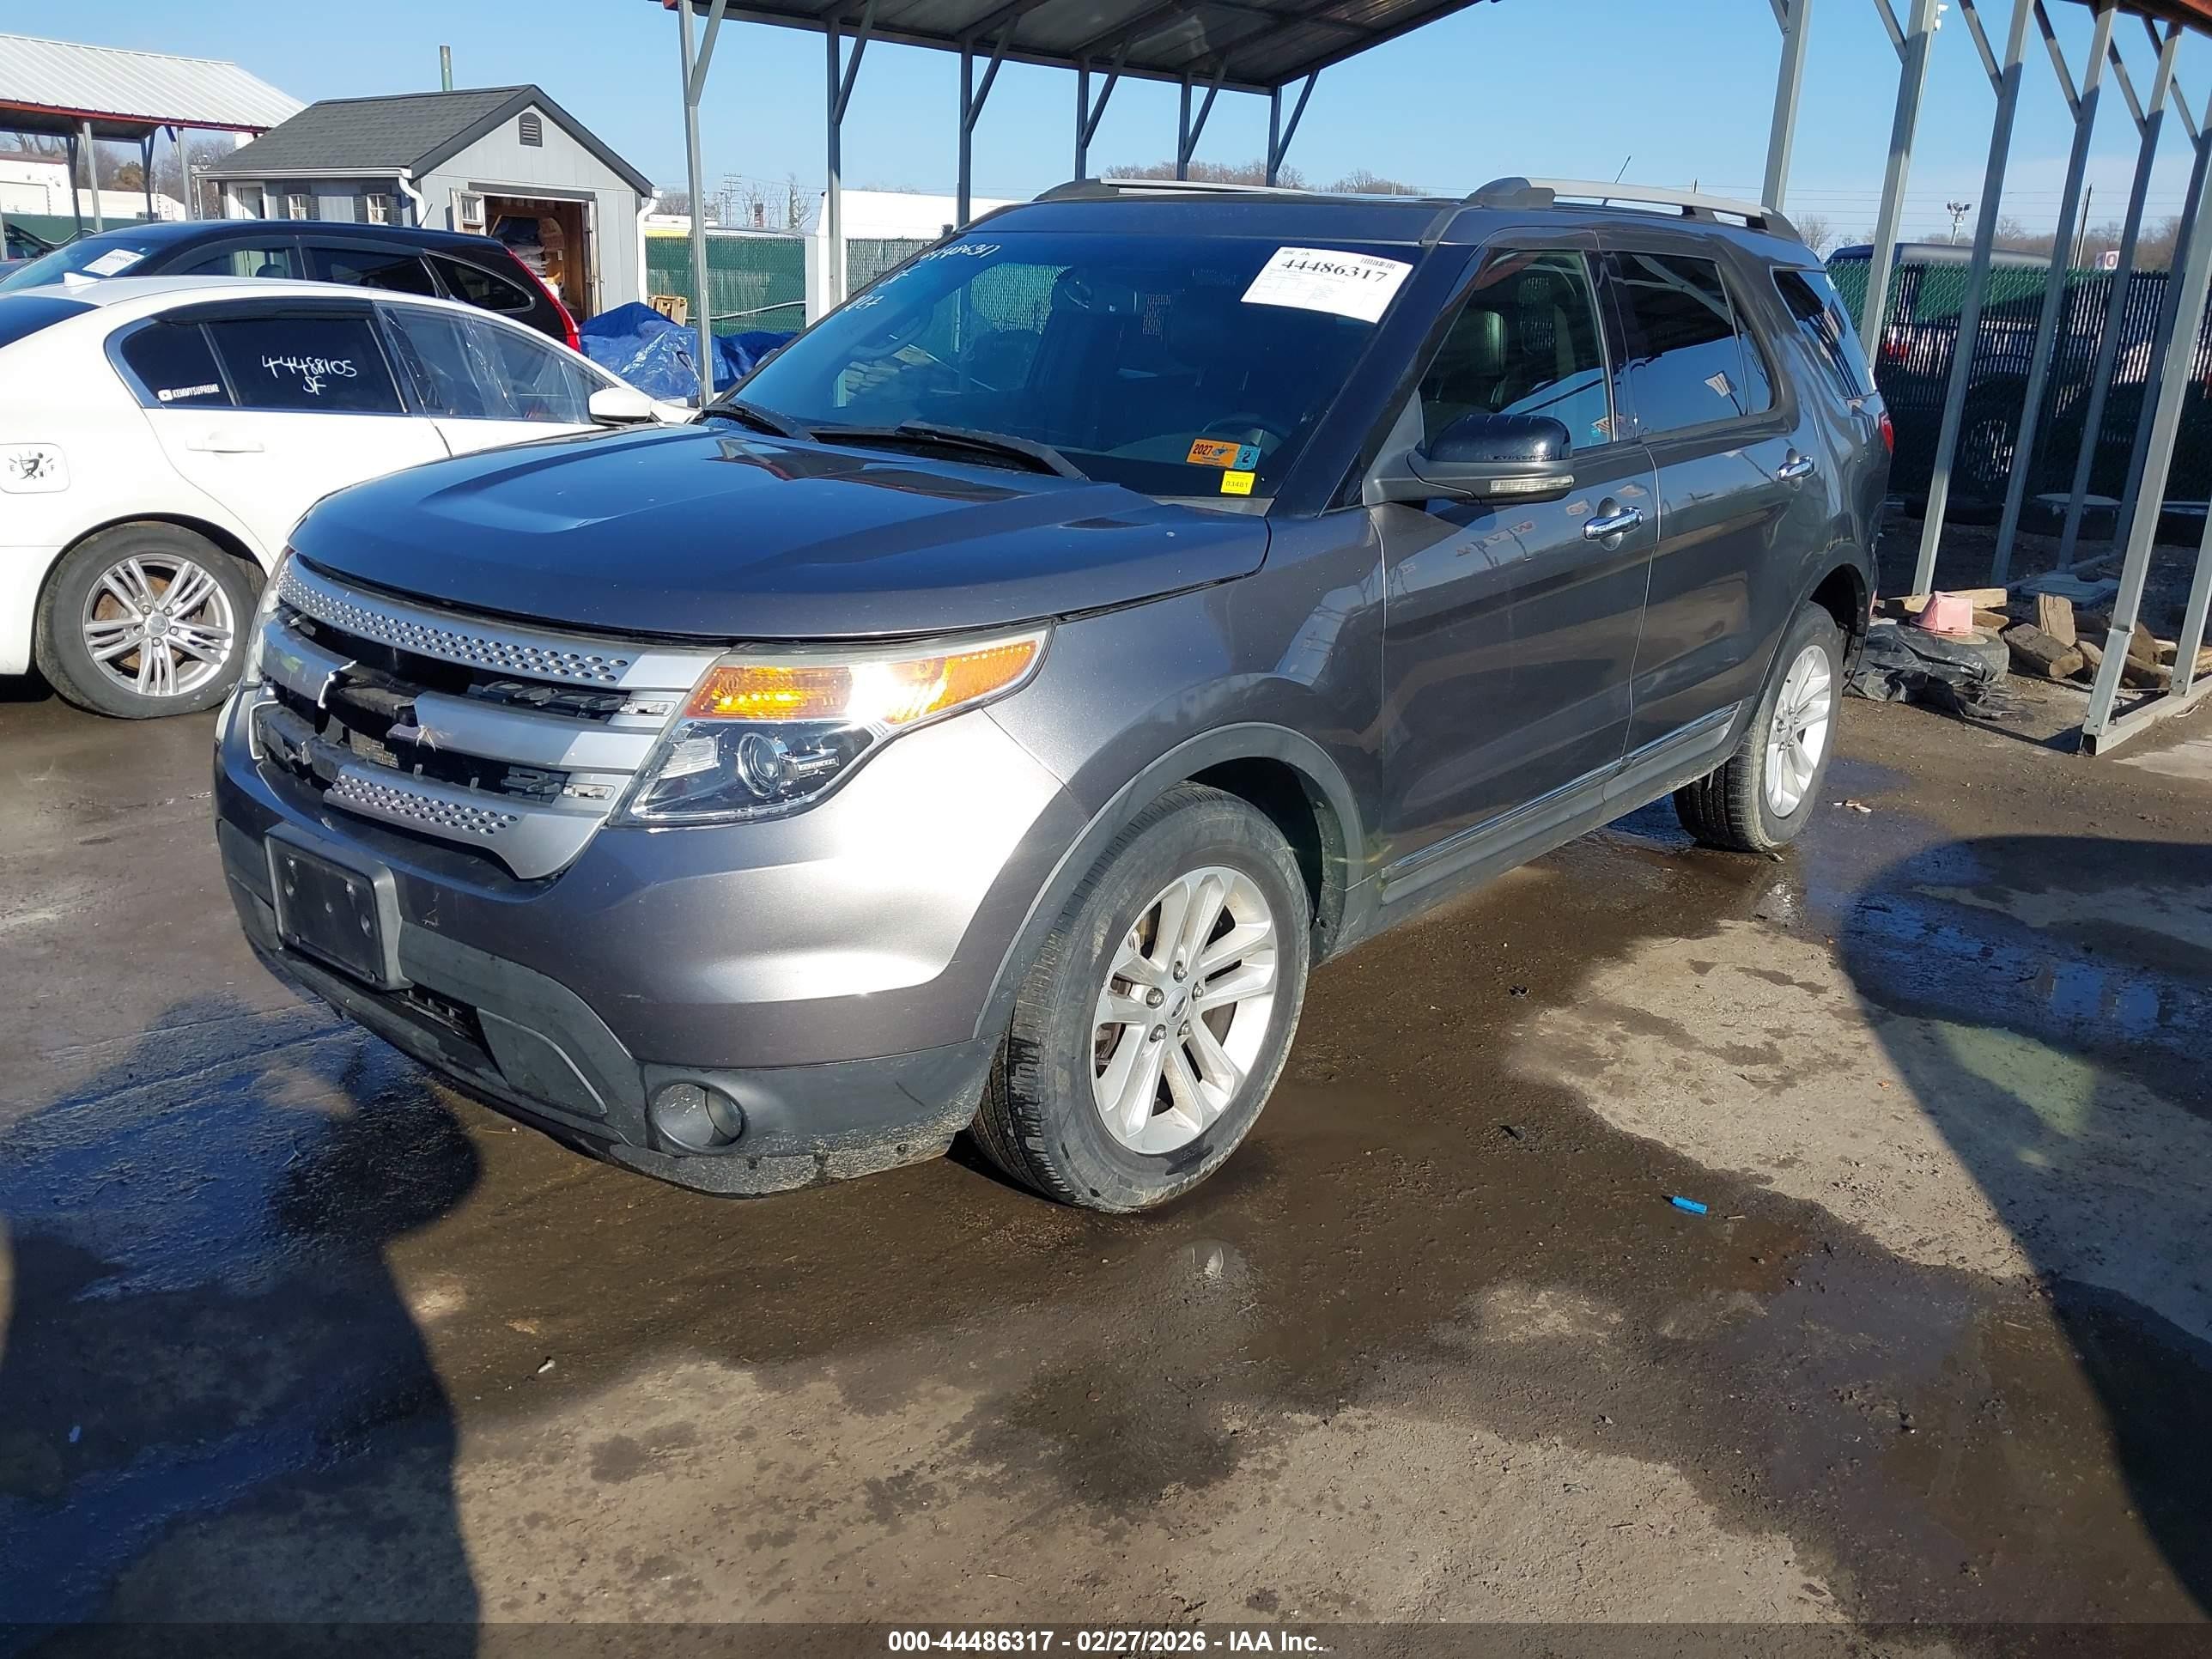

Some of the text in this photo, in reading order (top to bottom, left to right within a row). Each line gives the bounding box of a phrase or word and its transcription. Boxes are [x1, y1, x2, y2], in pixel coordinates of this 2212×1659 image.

[1280, 258, 1388, 283] 44486317
[262, 355, 357, 378] 44488105
[303, 376, 326, 395] SF
[1193, 444, 1212, 455] 2027
[1242, 451, 1251, 463] 2
